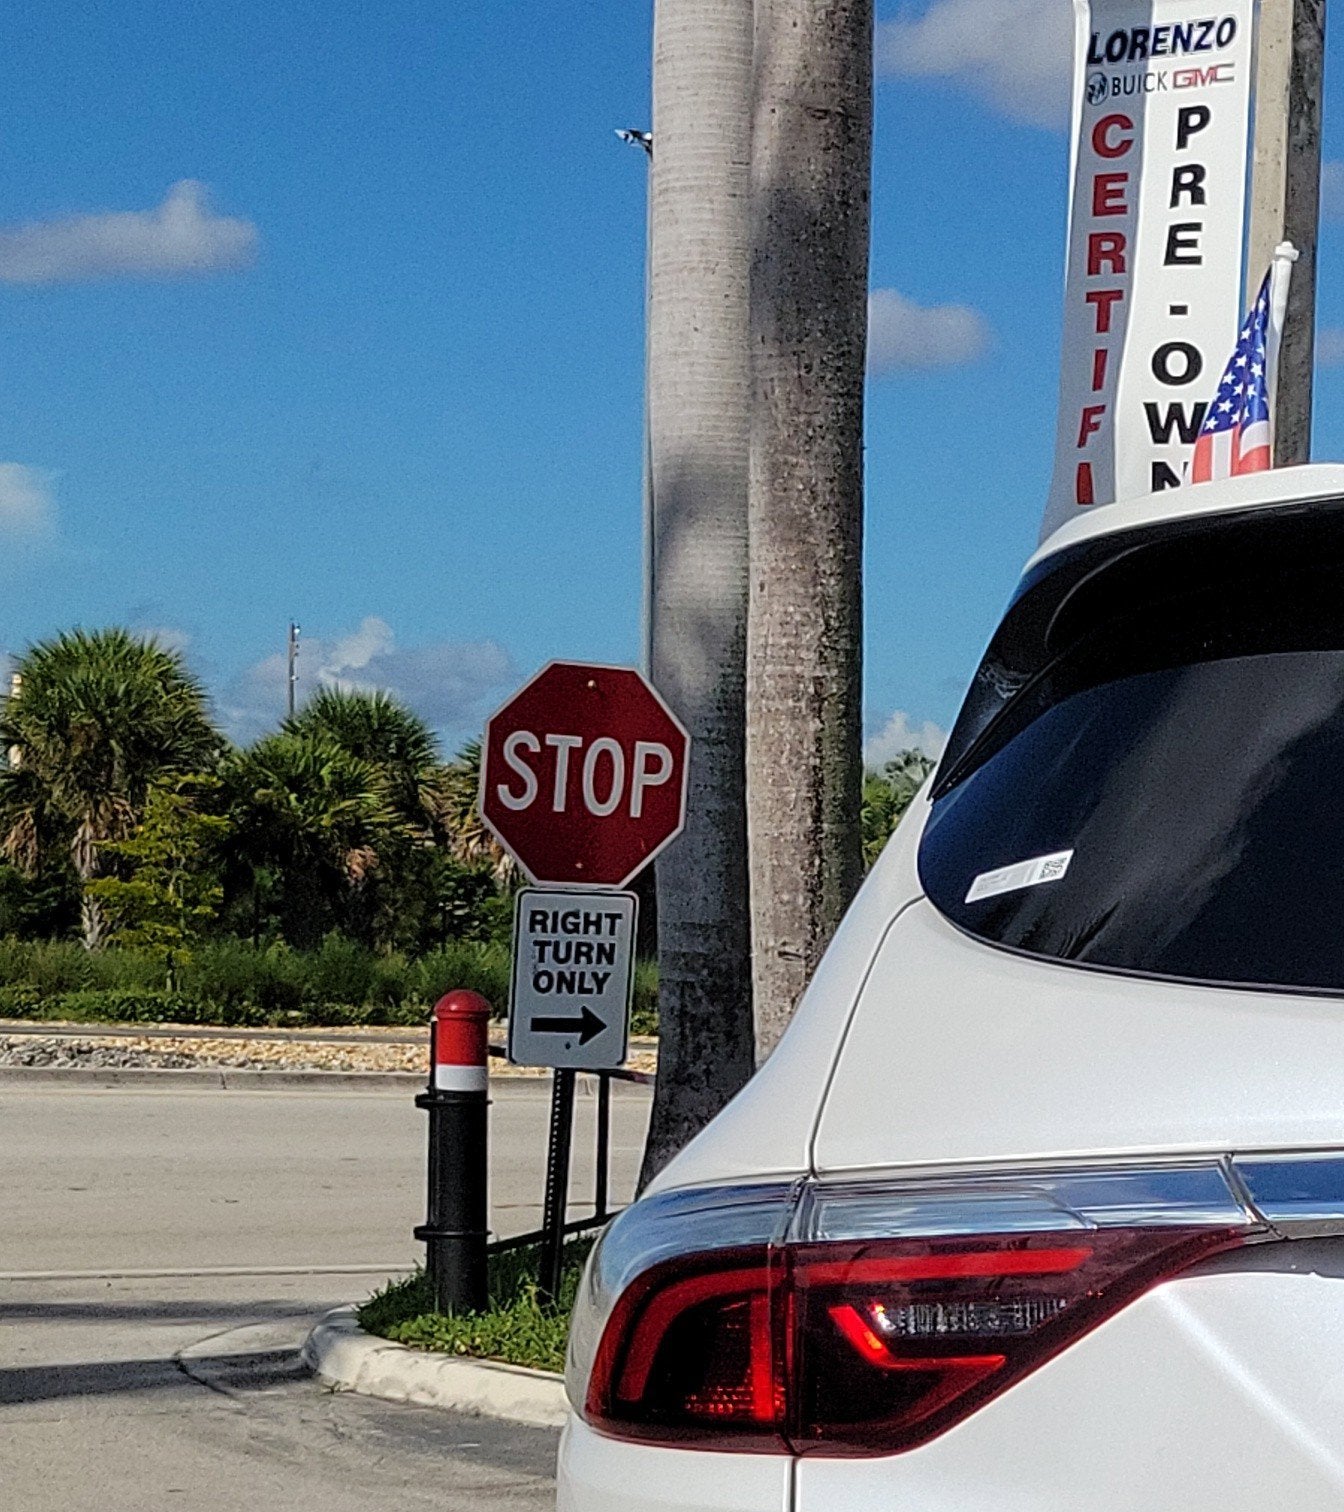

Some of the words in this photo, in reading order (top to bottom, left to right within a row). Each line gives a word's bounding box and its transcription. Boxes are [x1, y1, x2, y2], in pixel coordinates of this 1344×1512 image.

[1087, 16, 1237, 65] LORENZO
[1111, 70, 1168, 98] BUICK
[1172, 62, 1236, 89] GMC
[497, 730, 675, 819] STOP
[529, 909, 623, 937] RIGHT
[533, 939, 616, 966] TURN
[532, 969, 612, 996] ONLY
